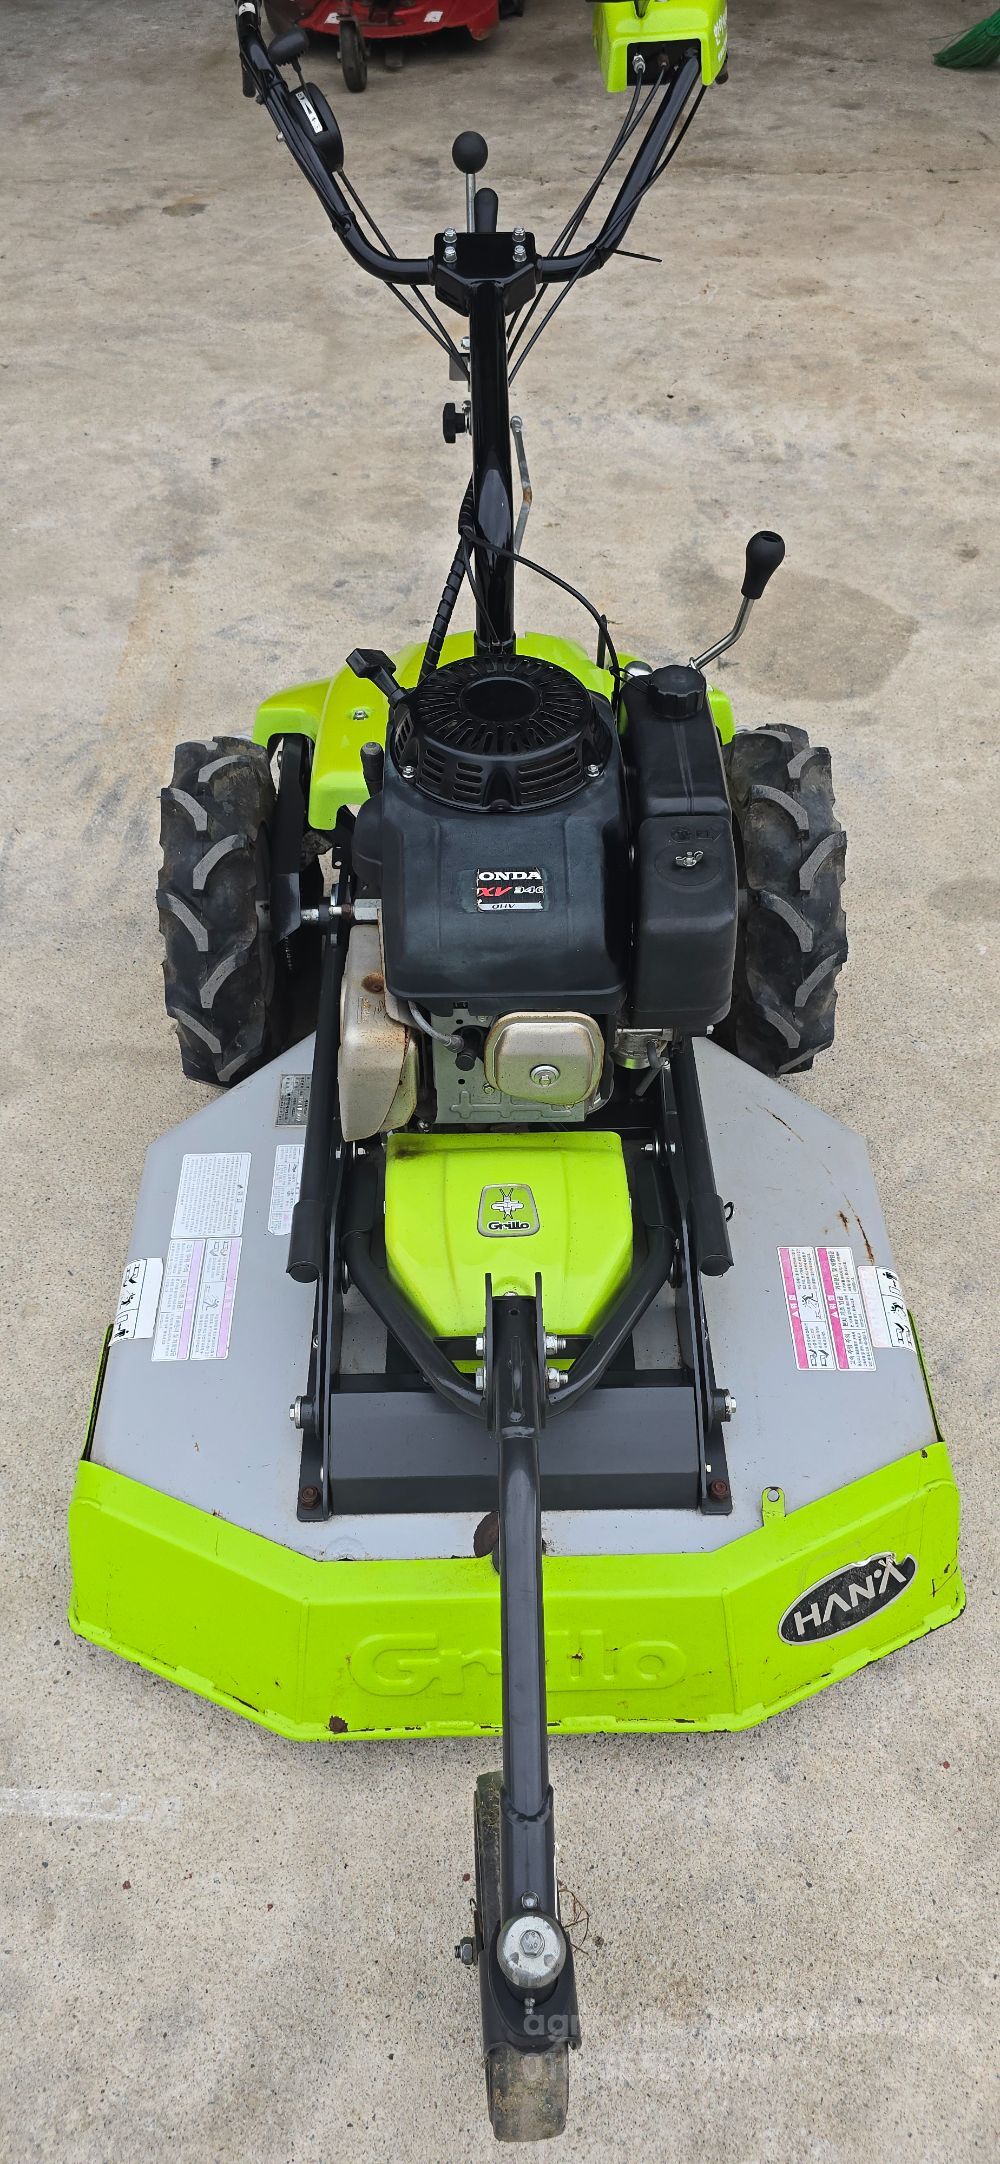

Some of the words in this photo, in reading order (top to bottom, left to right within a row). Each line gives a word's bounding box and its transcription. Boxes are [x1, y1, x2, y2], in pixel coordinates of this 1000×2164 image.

[478, 871, 542, 881] ONDA
[488, 1221, 530, 1230] Grillo
[348, 1629, 687, 1697] Grllo
